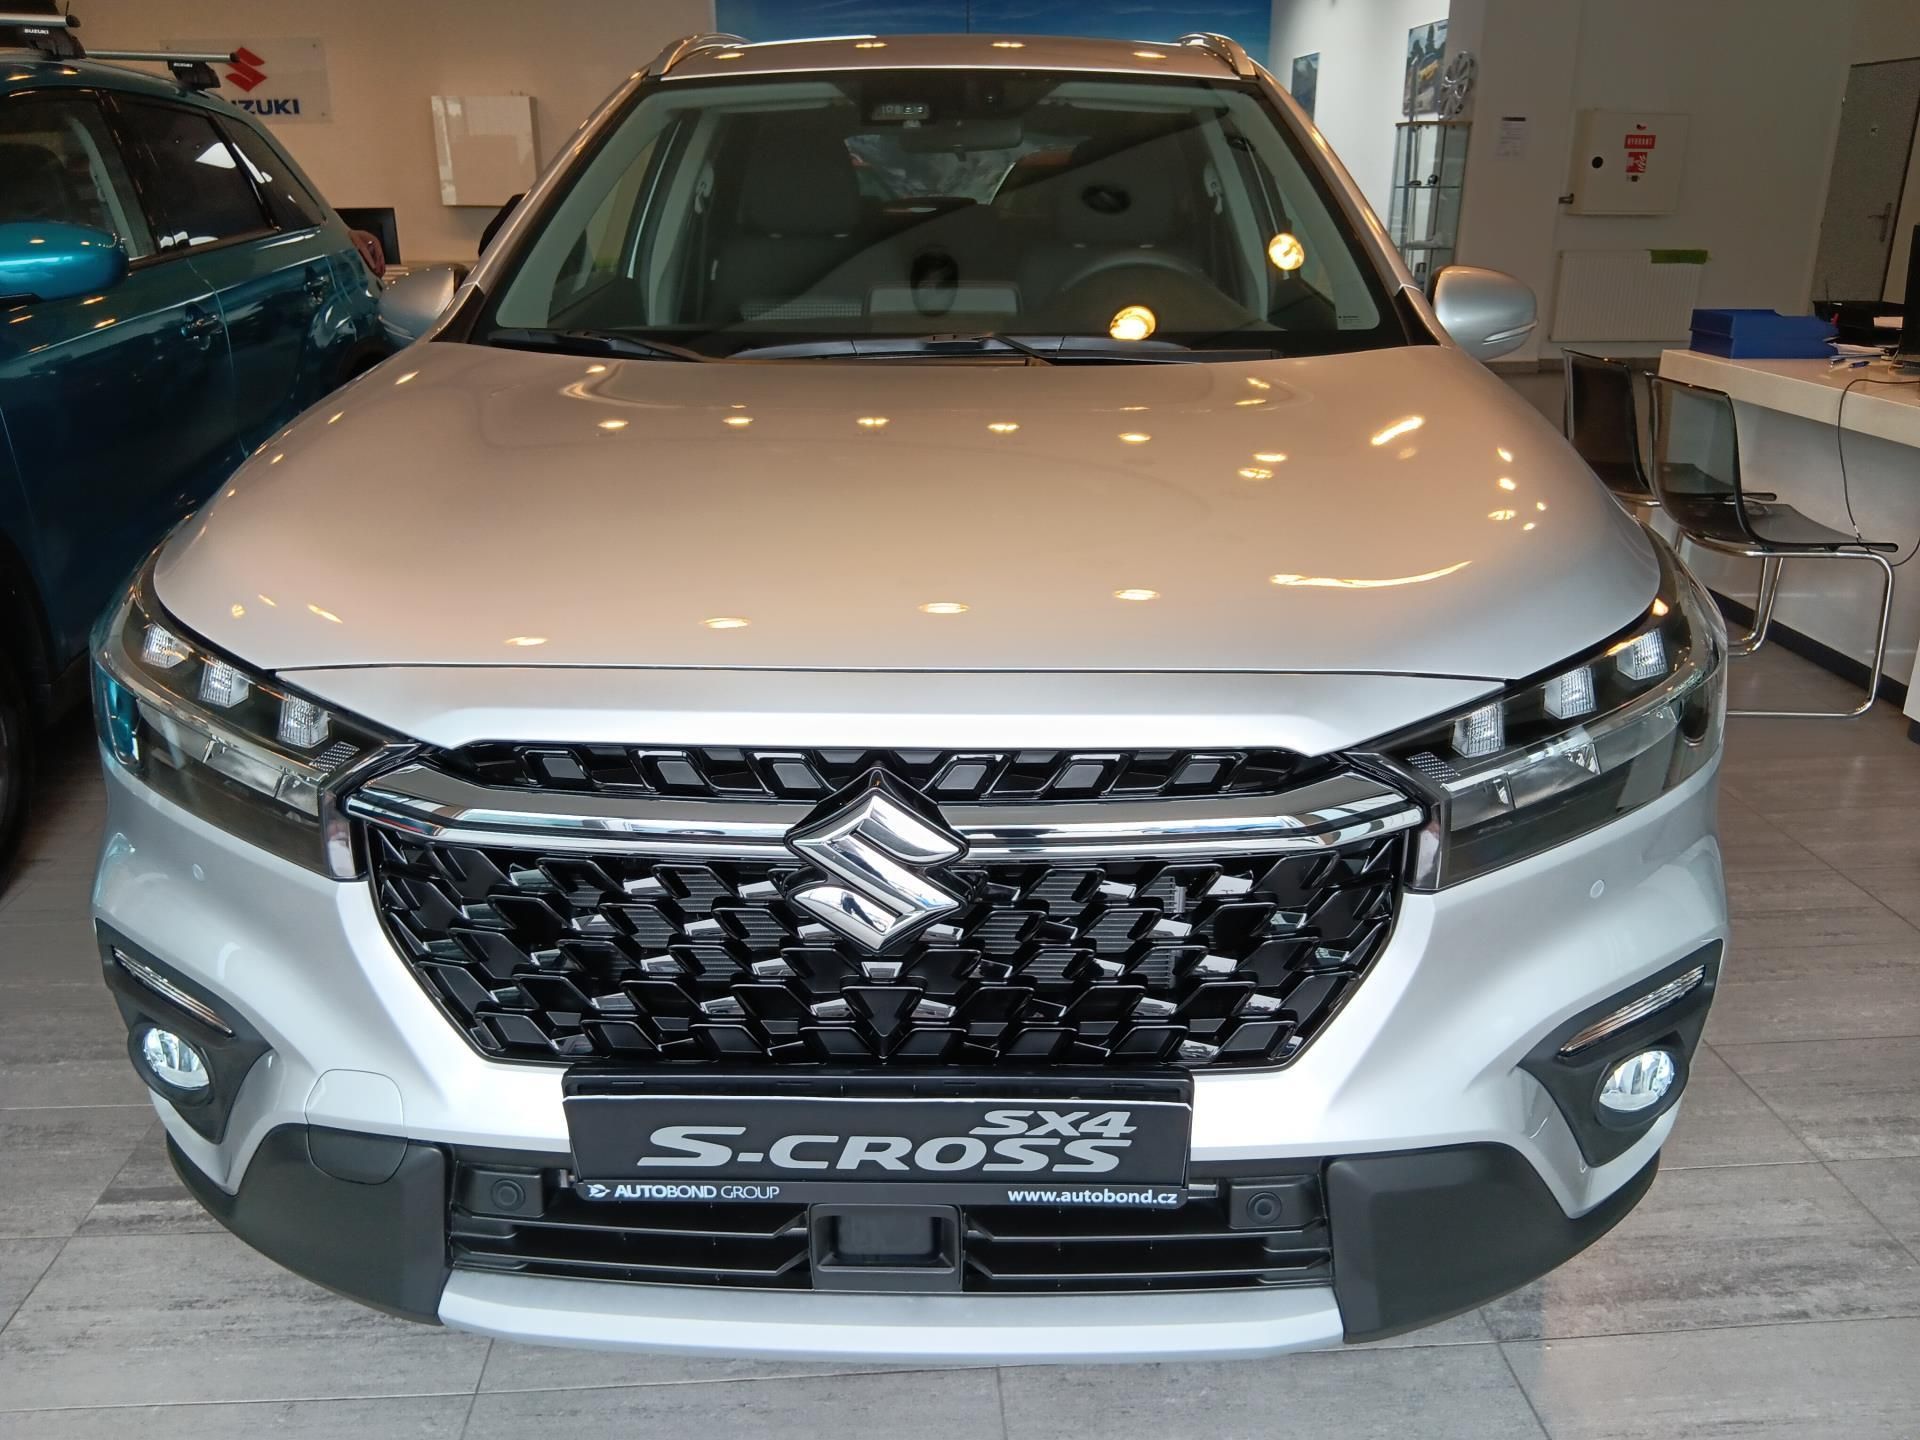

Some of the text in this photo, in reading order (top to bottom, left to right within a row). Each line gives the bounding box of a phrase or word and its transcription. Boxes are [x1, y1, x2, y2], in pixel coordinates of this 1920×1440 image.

[231, 98, 301, 116] ZUKI
[968, 1109, 1138, 1138] SX4
[636, 1125, 1133, 1173] S-CROSS
[613, 1183, 780, 1199] AUTOBOND GROUP
[1007, 1188, 1178, 1205] www.autobond.cz
